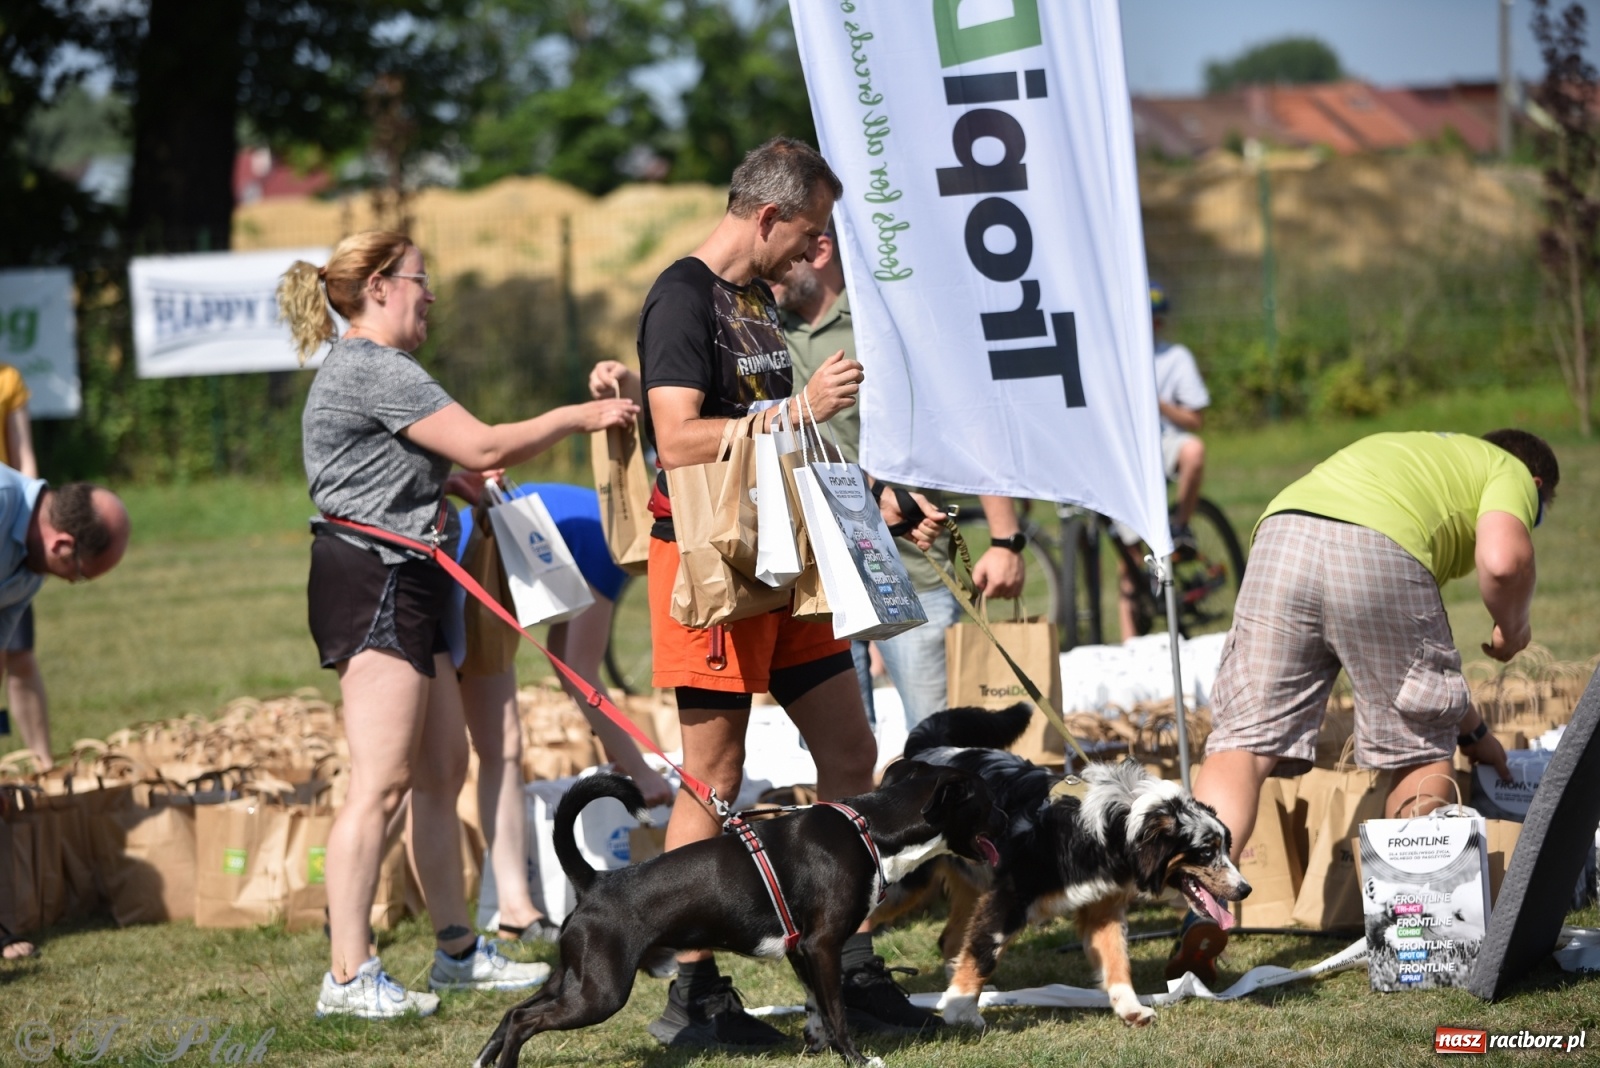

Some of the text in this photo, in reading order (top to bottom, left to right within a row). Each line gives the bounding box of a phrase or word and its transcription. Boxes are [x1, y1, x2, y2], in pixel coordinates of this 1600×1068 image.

[1388, 836, 1450, 848] FRONTLINE
[1395, 892, 1452, 904] FRONTLINE
[1396, 904, 1421, 912] TRI-ACT
[1397, 916, 1453, 928] FRONTLINE
[1398, 929, 1421, 937] COMBO
[1398, 940, 1454, 951] FRONTLINE
[1399, 962, 1455, 974] FRONTLINE
[1401, 974, 1421, 982] SPRAY
